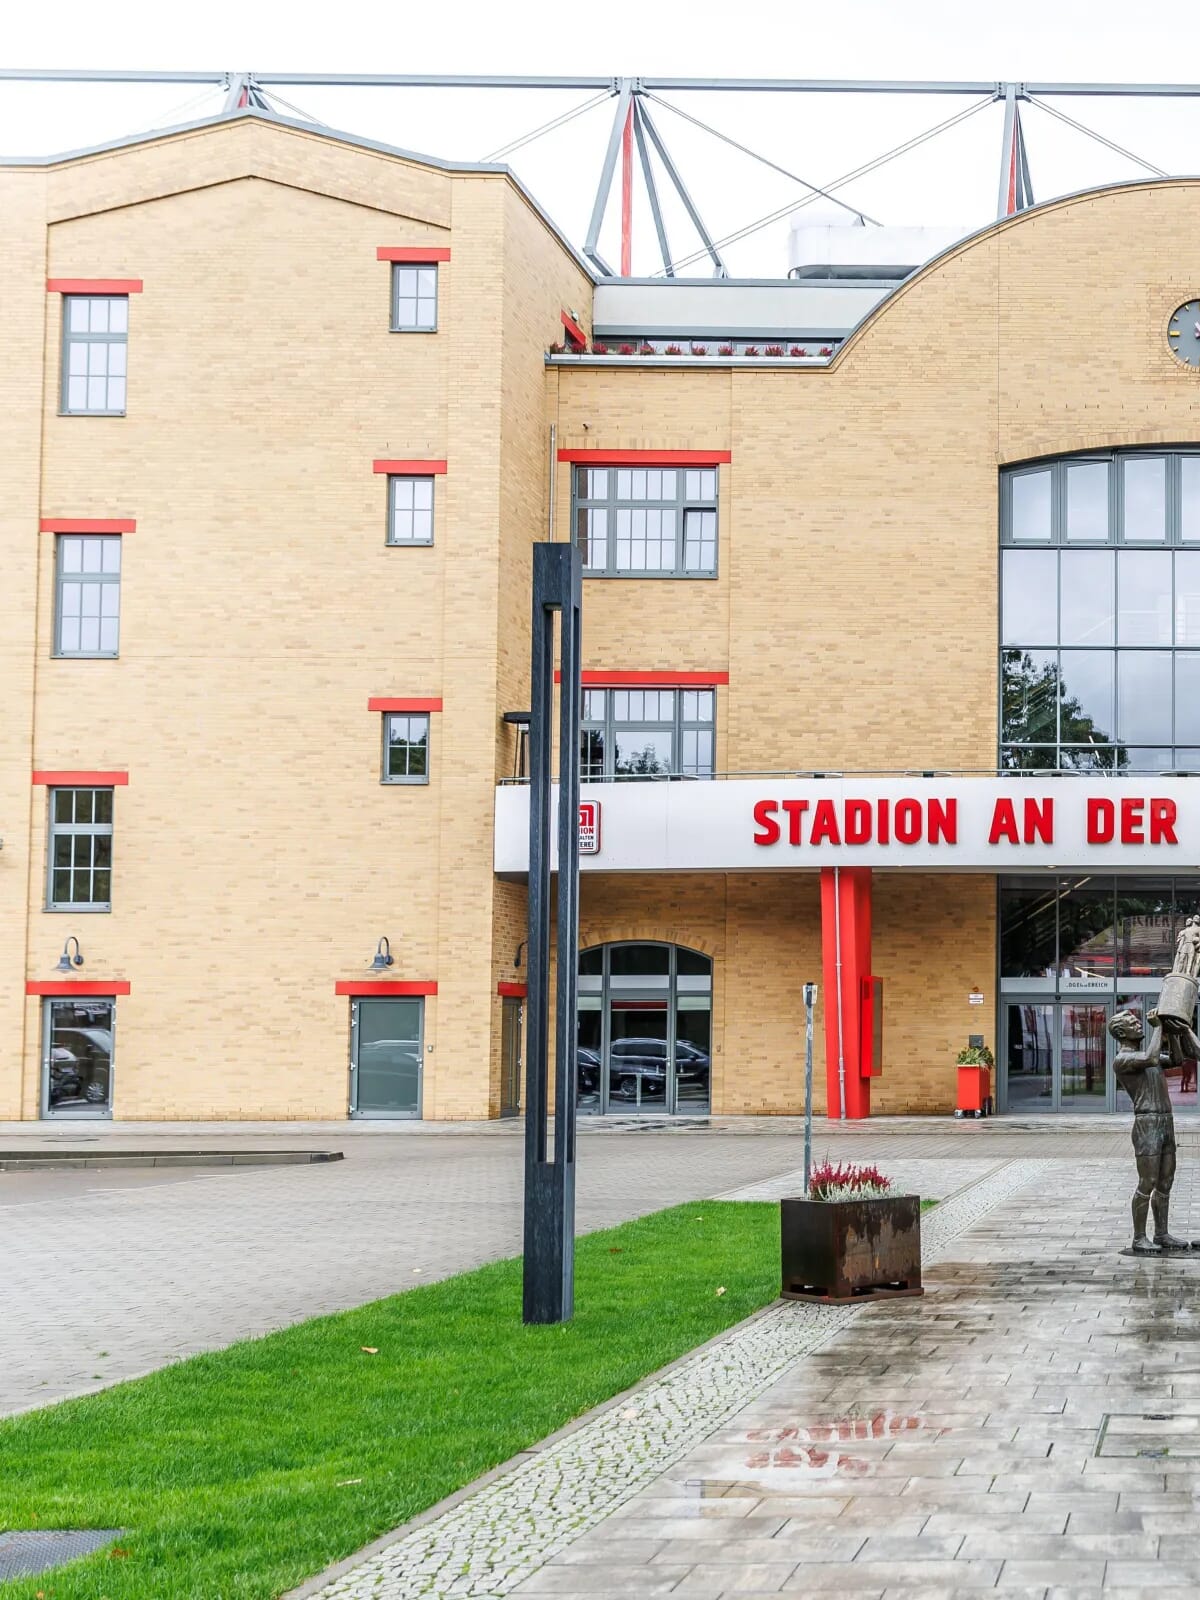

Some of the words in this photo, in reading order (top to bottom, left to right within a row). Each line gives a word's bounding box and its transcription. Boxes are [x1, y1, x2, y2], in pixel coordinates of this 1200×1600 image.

[754, 798, 957, 845] STADION
[989, 798, 1054, 844] AN
[1086, 798, 1178, 844] DER
